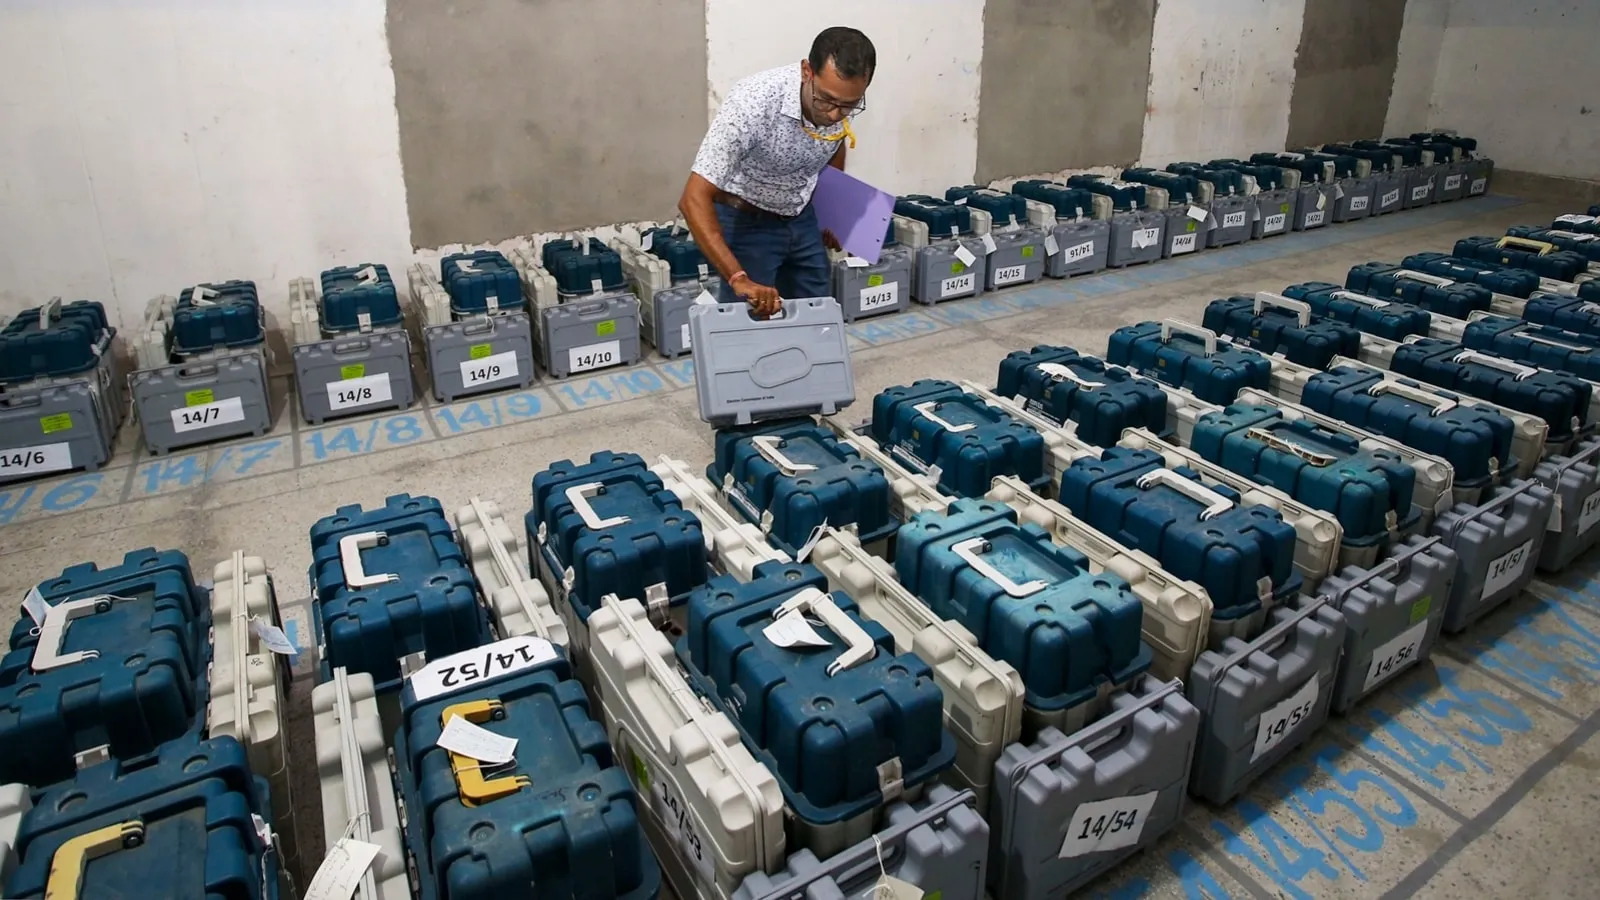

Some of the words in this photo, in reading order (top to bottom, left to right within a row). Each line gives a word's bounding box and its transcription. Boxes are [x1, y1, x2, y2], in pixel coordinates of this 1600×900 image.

[1070, 244, 1090, 258] 14/16
[945, 277, 970, 290] 14/14
[998, 268, 1020, 279] 14/15
[864, 292, 892, 305] 14/13
[576, 351, 612, 367] 14/10
[469, 365, 501, 381] 14/9
[337, 387, 372, 403] 14/8
[561, 368, 664, 407] 14/10
[181, 407, 220, 425] 14/7
[436, 394, 542, 433] 14/9
[306, 414, 424, 460] 14/8
[0, 451, 45, 468] 14/6
[139, 440, 281, 493] 14/7
[1491, 548, 1524, 581] 14/57
[437, 644, 535, 687] 14/52
[1373, 642, 1414, 678] 14/56
[1265, 700, 1312, 744] 14/55
[1076, 808, 1139, 841] 14/54
